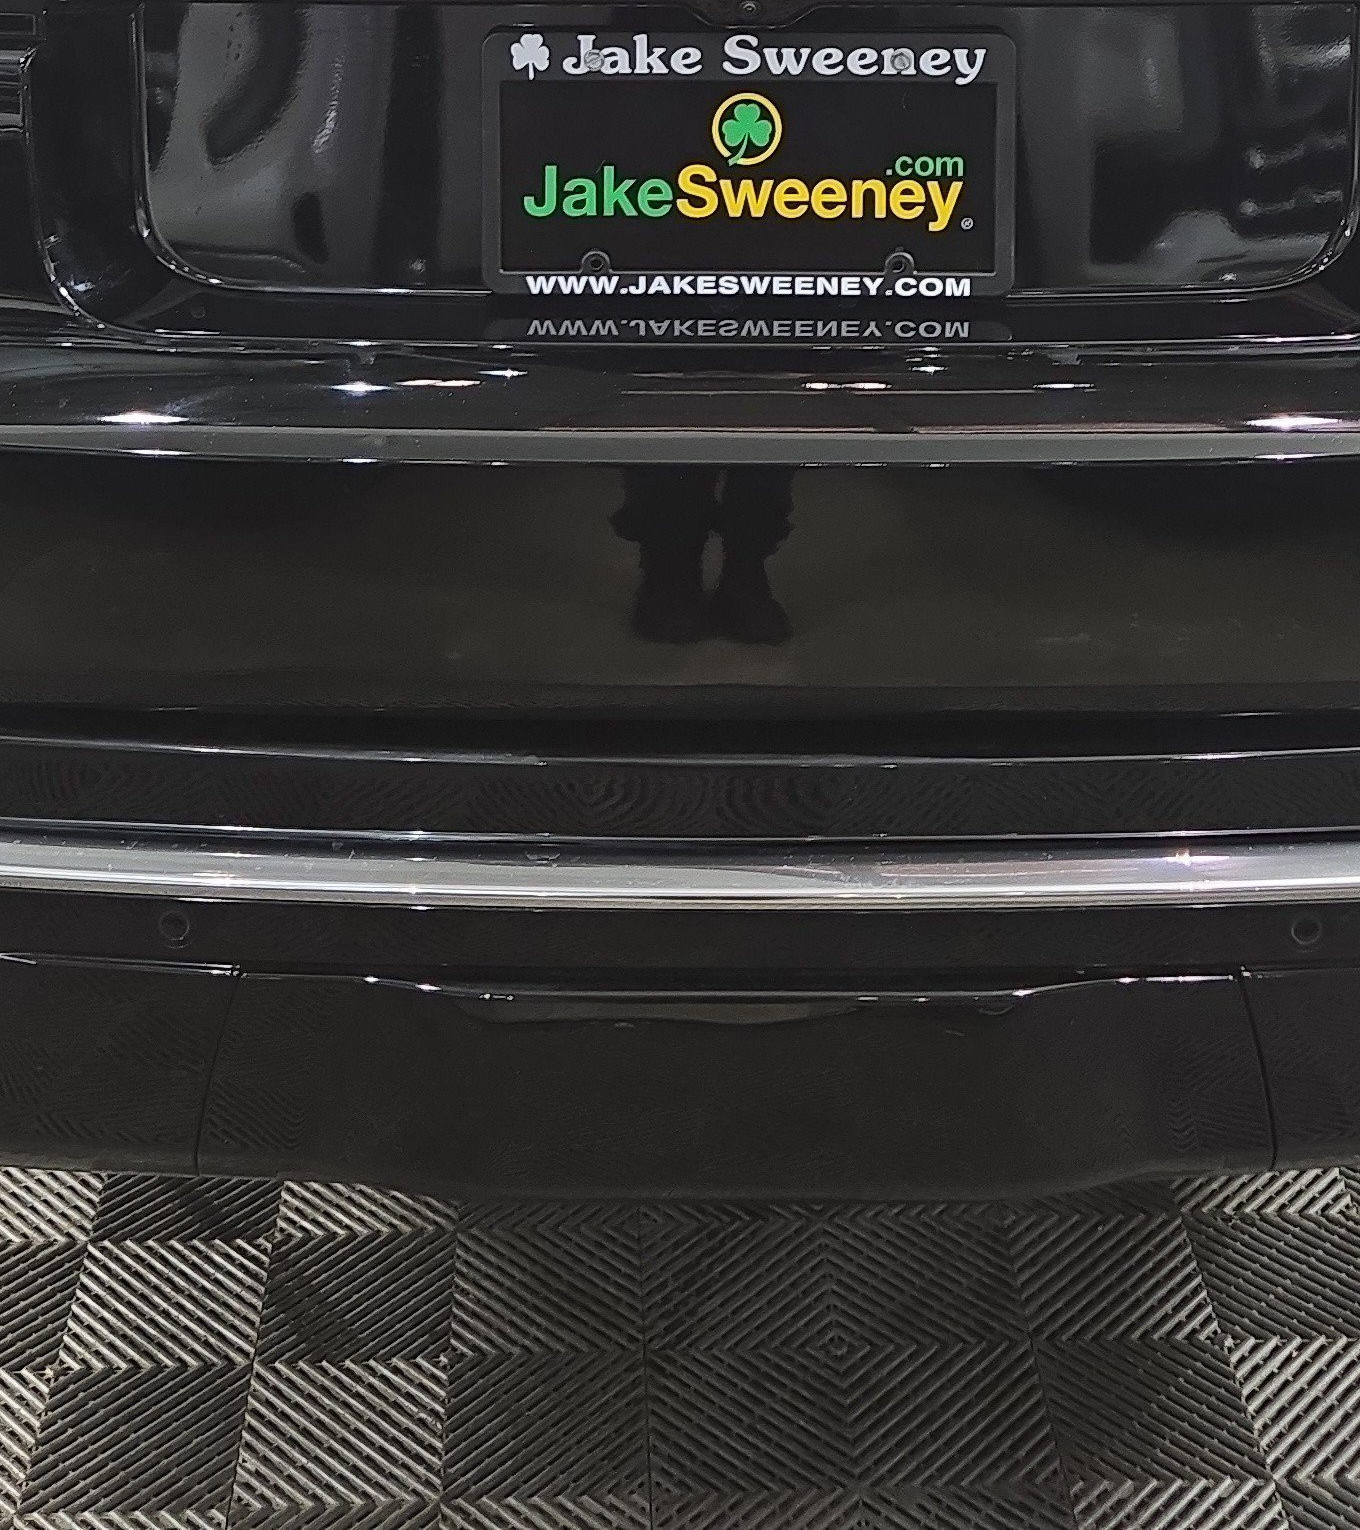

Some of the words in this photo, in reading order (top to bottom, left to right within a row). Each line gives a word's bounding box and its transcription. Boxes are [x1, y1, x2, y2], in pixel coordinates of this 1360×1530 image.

[562, 34, 703, 76] Jake
[722, 34, 987, 85] Sweeney
[885, 155, 964, 177] .com
[524, 164, 963, 232] JakeSweeney
[526, 275, 971, 297] WWW.JAKESWEENEY.COM
